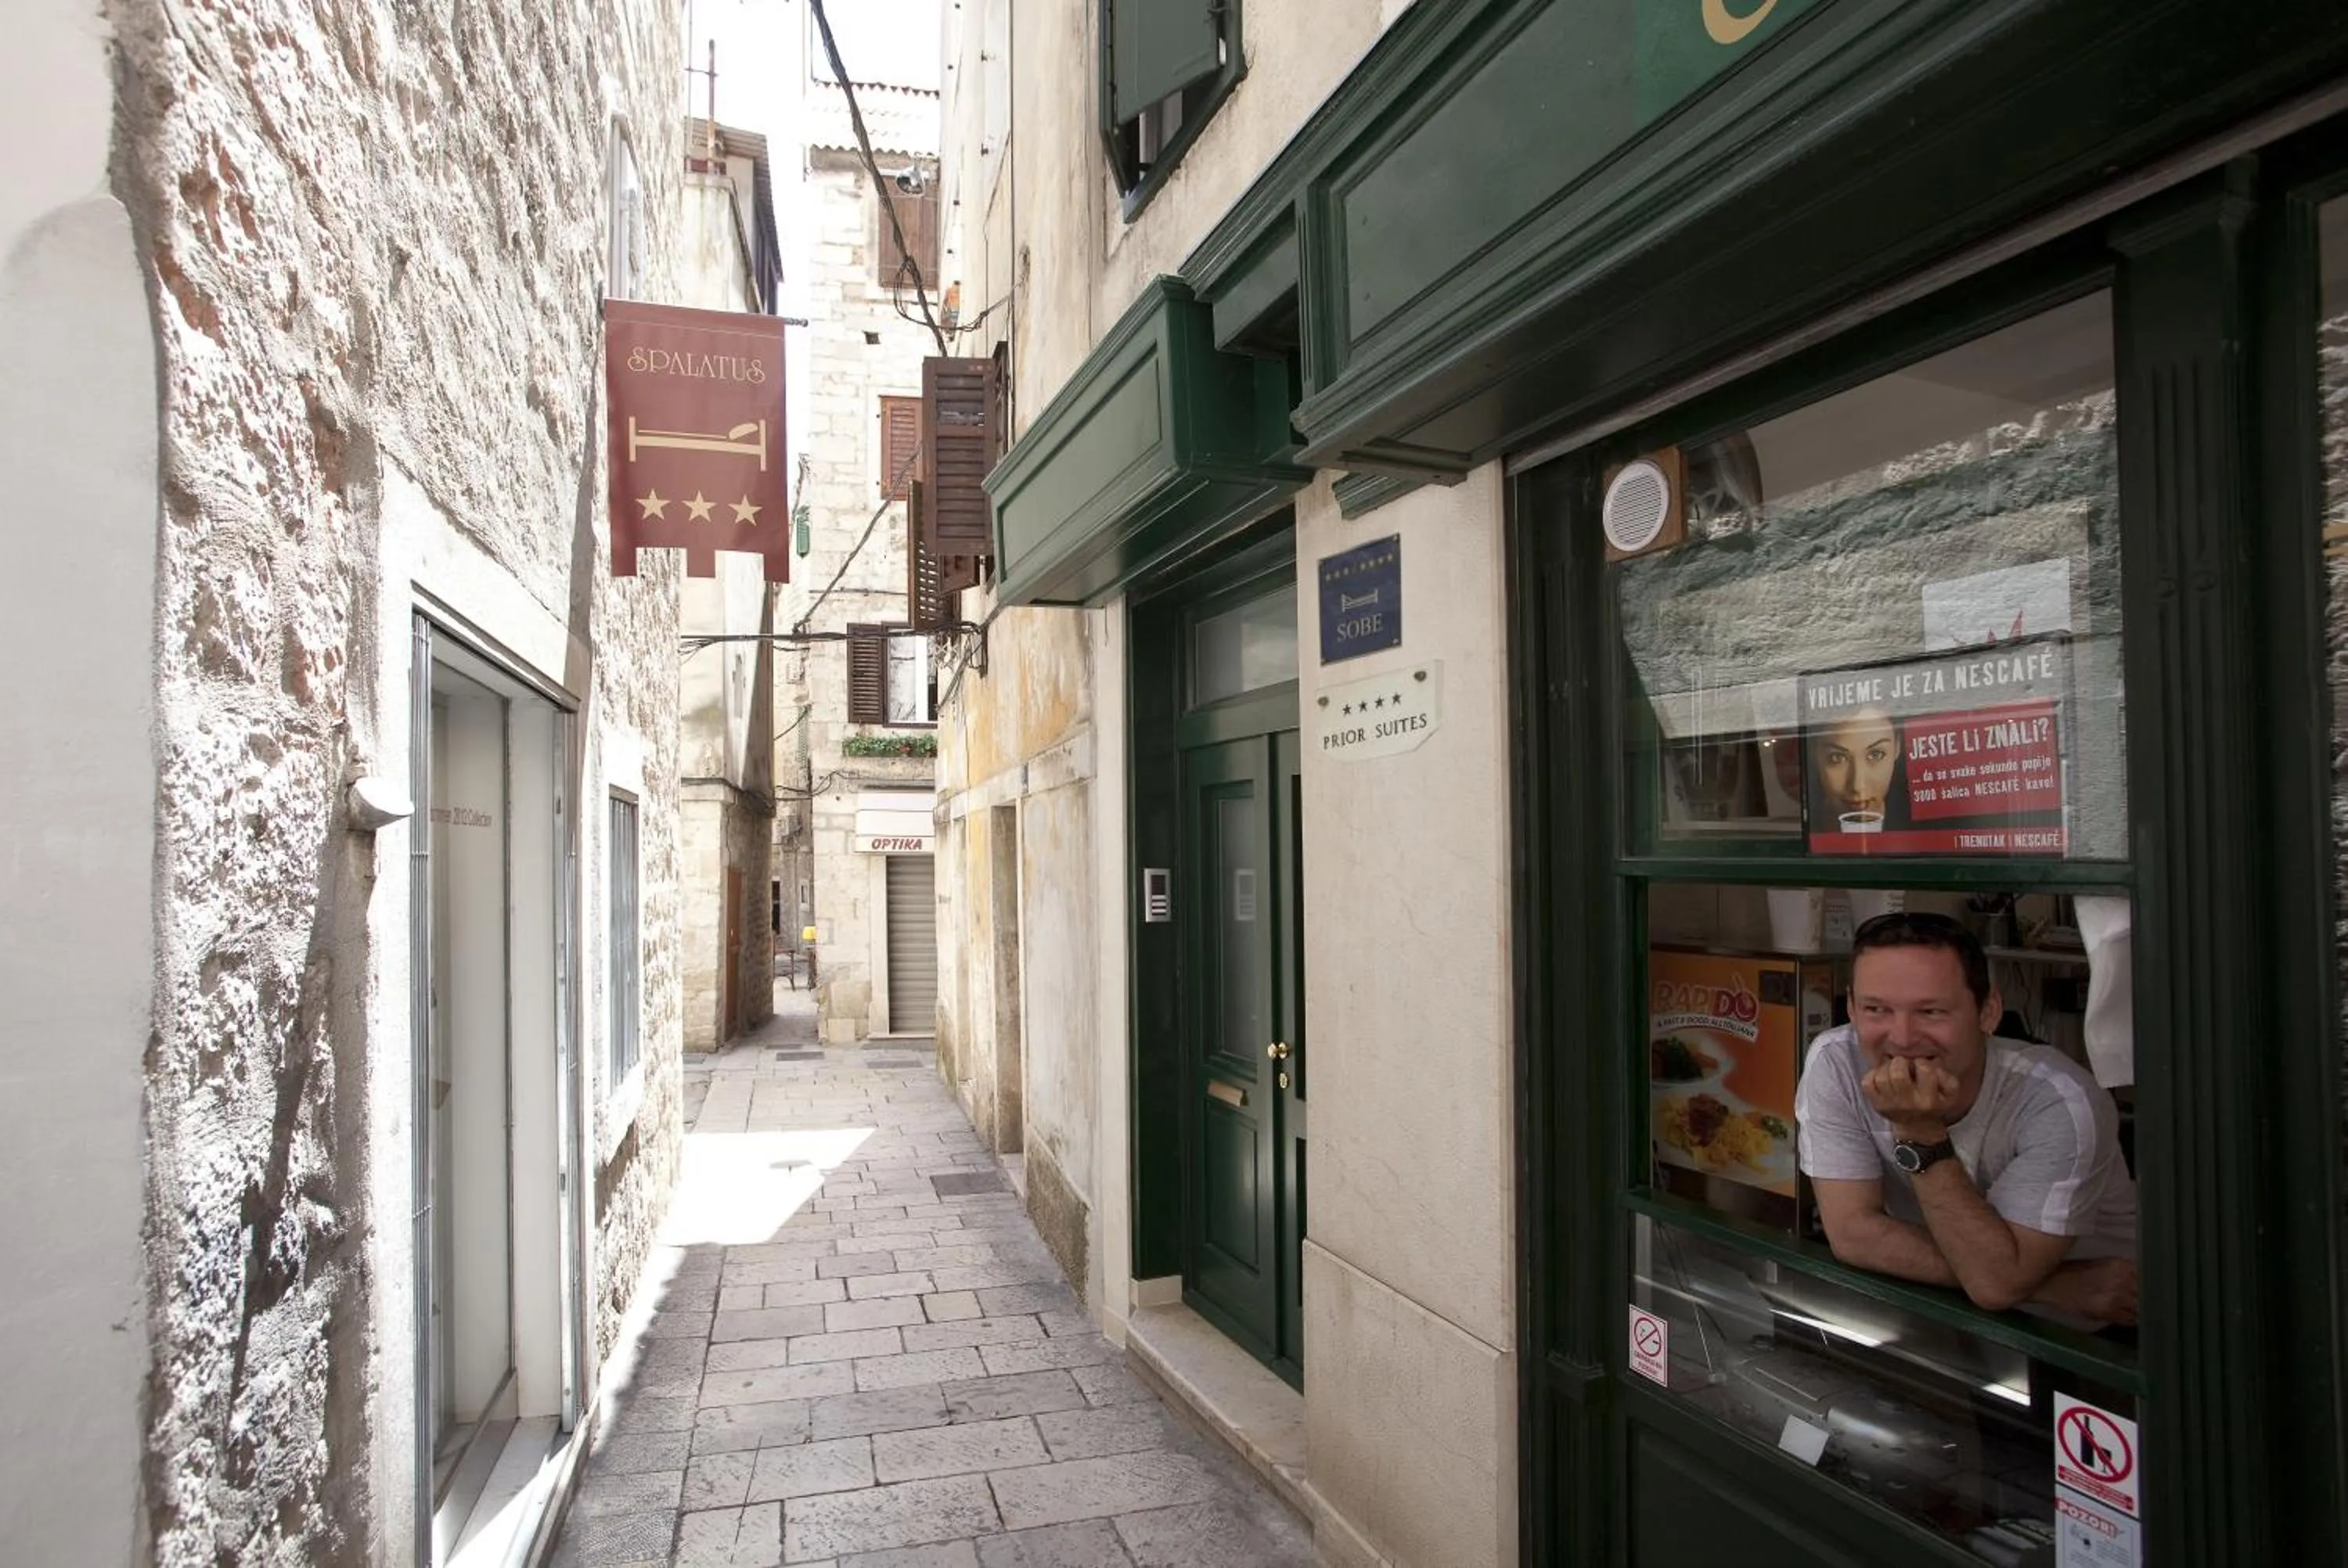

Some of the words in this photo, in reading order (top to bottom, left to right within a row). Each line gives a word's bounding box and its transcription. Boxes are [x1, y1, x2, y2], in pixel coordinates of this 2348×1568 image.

[627, 346, 766, 384] SPALATUS
[1337, 613, 1384, 642] SOBE
[1891, 674, 1914, 698] JE
[1922, 670, 1945, 694] ZA
[1955, 650, 2054, 690] NESCAFÉ
[1323, 728, 1366, 750] PRIOR
[1375, 713, 1428, 739] SUITES
[1909, 732, 1957, 761] JESTE
[871, 838, 923, 850] OPTIKA
